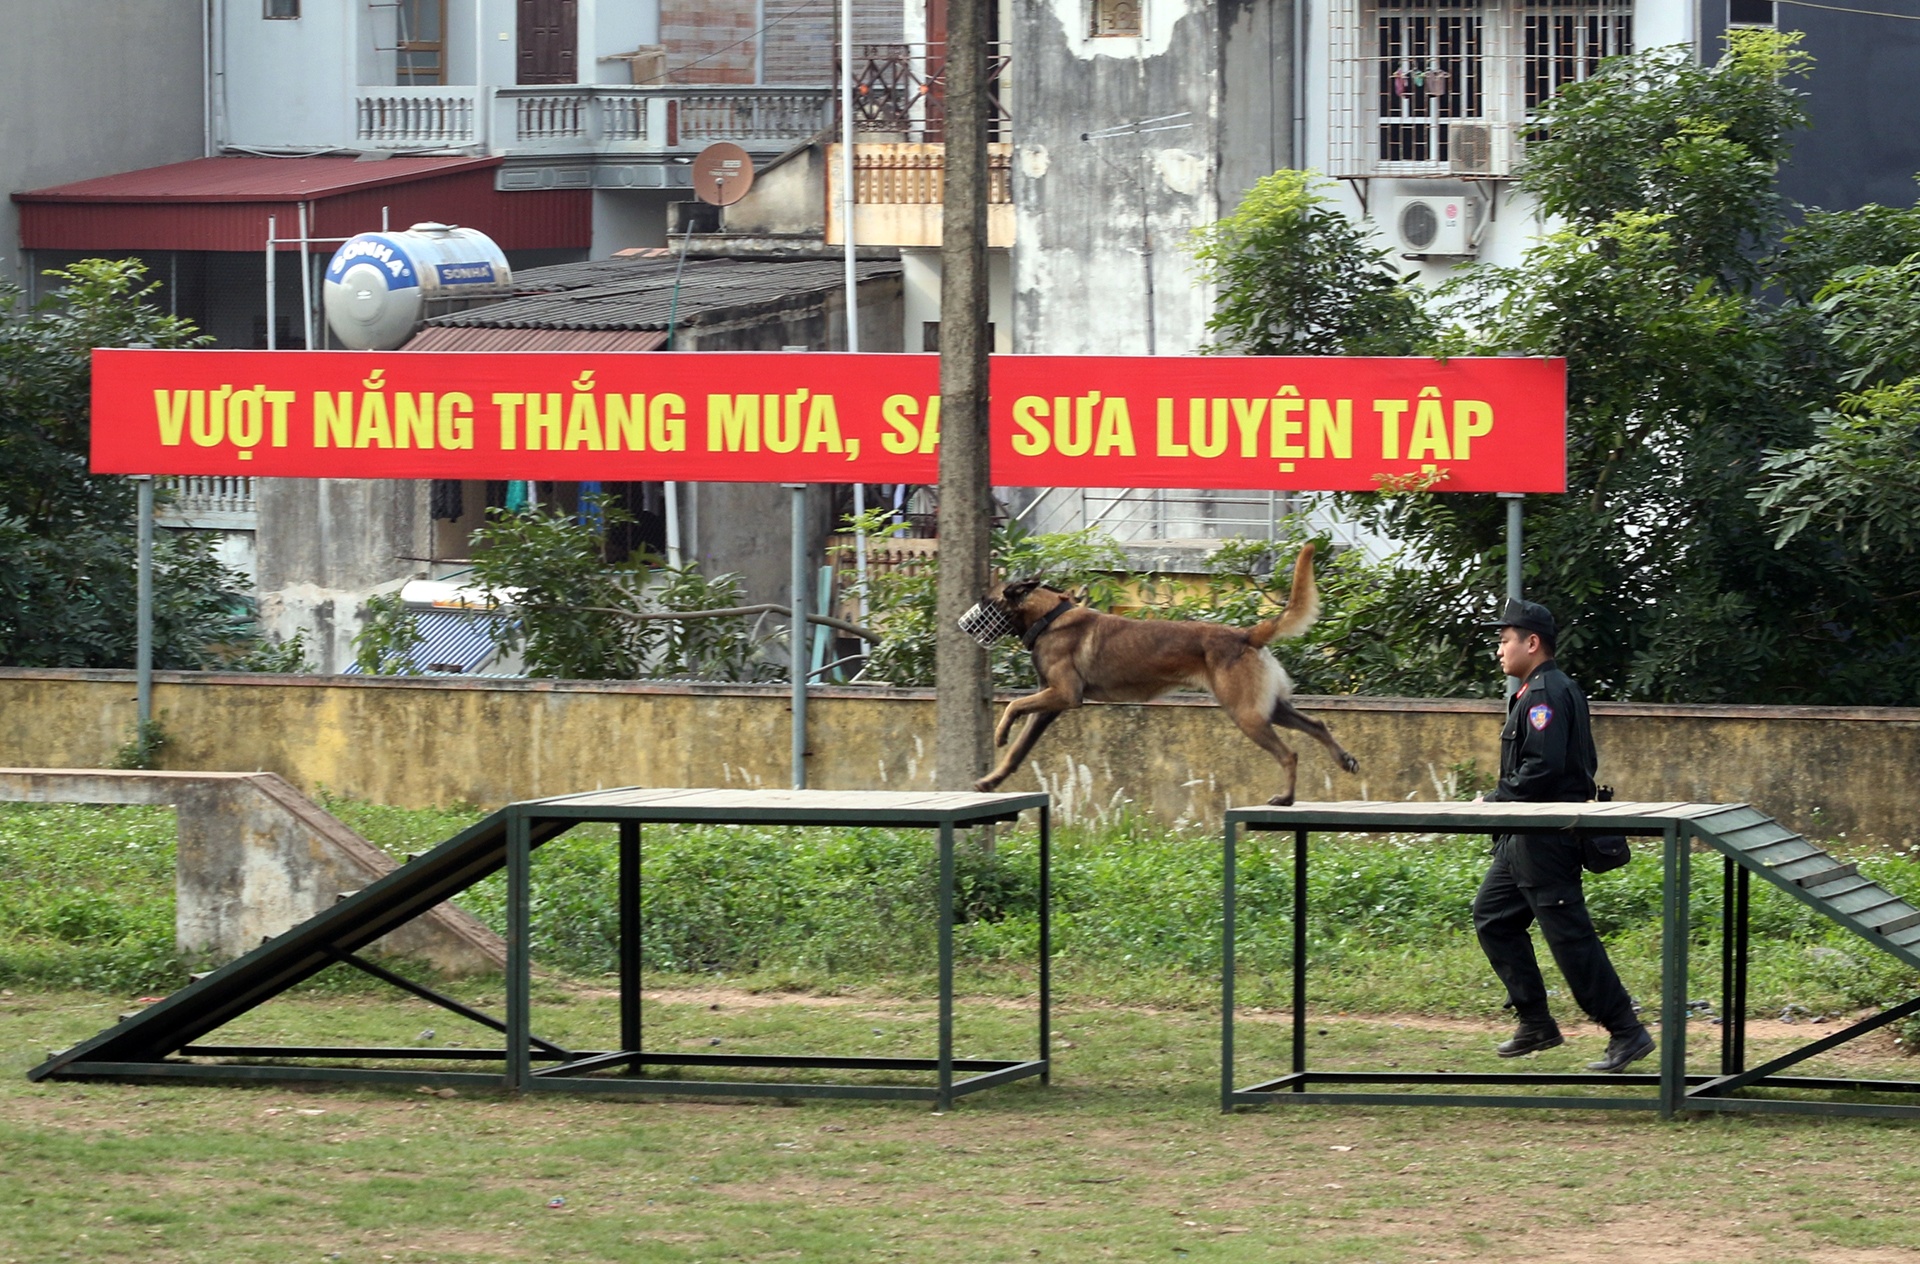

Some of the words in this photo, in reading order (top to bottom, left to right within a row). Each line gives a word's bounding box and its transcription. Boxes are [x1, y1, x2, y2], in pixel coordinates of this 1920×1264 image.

[154, 384, 296, 461] VƯỢT
[313, 369, 474, 450] NẮNG
[492, 370, 686, 452] THẮNG
[707, 388, 861, 462] MƯA,
[1012, 391, 1137, 457] SƯA
[1157, 385, 1353, 473] LUYỆN
[1373, 386, 1494, 475] TẬP
